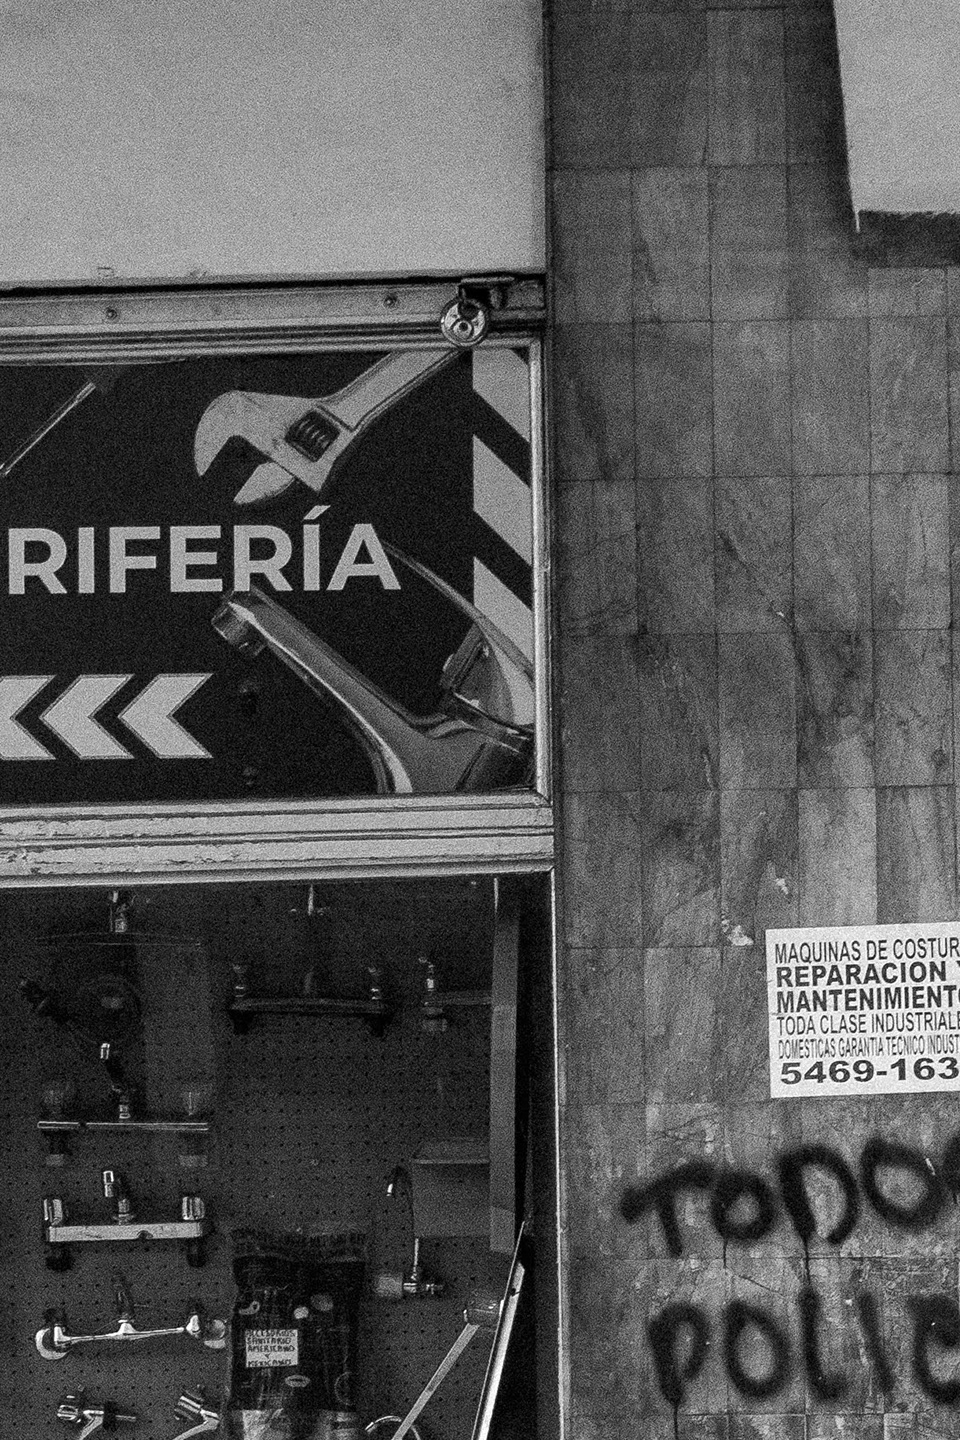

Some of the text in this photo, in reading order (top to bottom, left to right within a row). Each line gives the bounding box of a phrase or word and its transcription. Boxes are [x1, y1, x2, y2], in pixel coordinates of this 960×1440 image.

[8, 505, 401, 595] RIFERÍA
[775, 940, 861, 964] MAQUINAS
[866, 939, 888, 960] DE
[776, 961, 946, 987] REPARACION
[777, 1015, 816, 1035] TODA
[820, 1014, 867, 1034] CLASE
[778, 1038, 835, 1060] DOMESTICAS
[838, 1036, 884, 1058] GARANTIA
[886, 1034, 925, 1056] TECNICO
